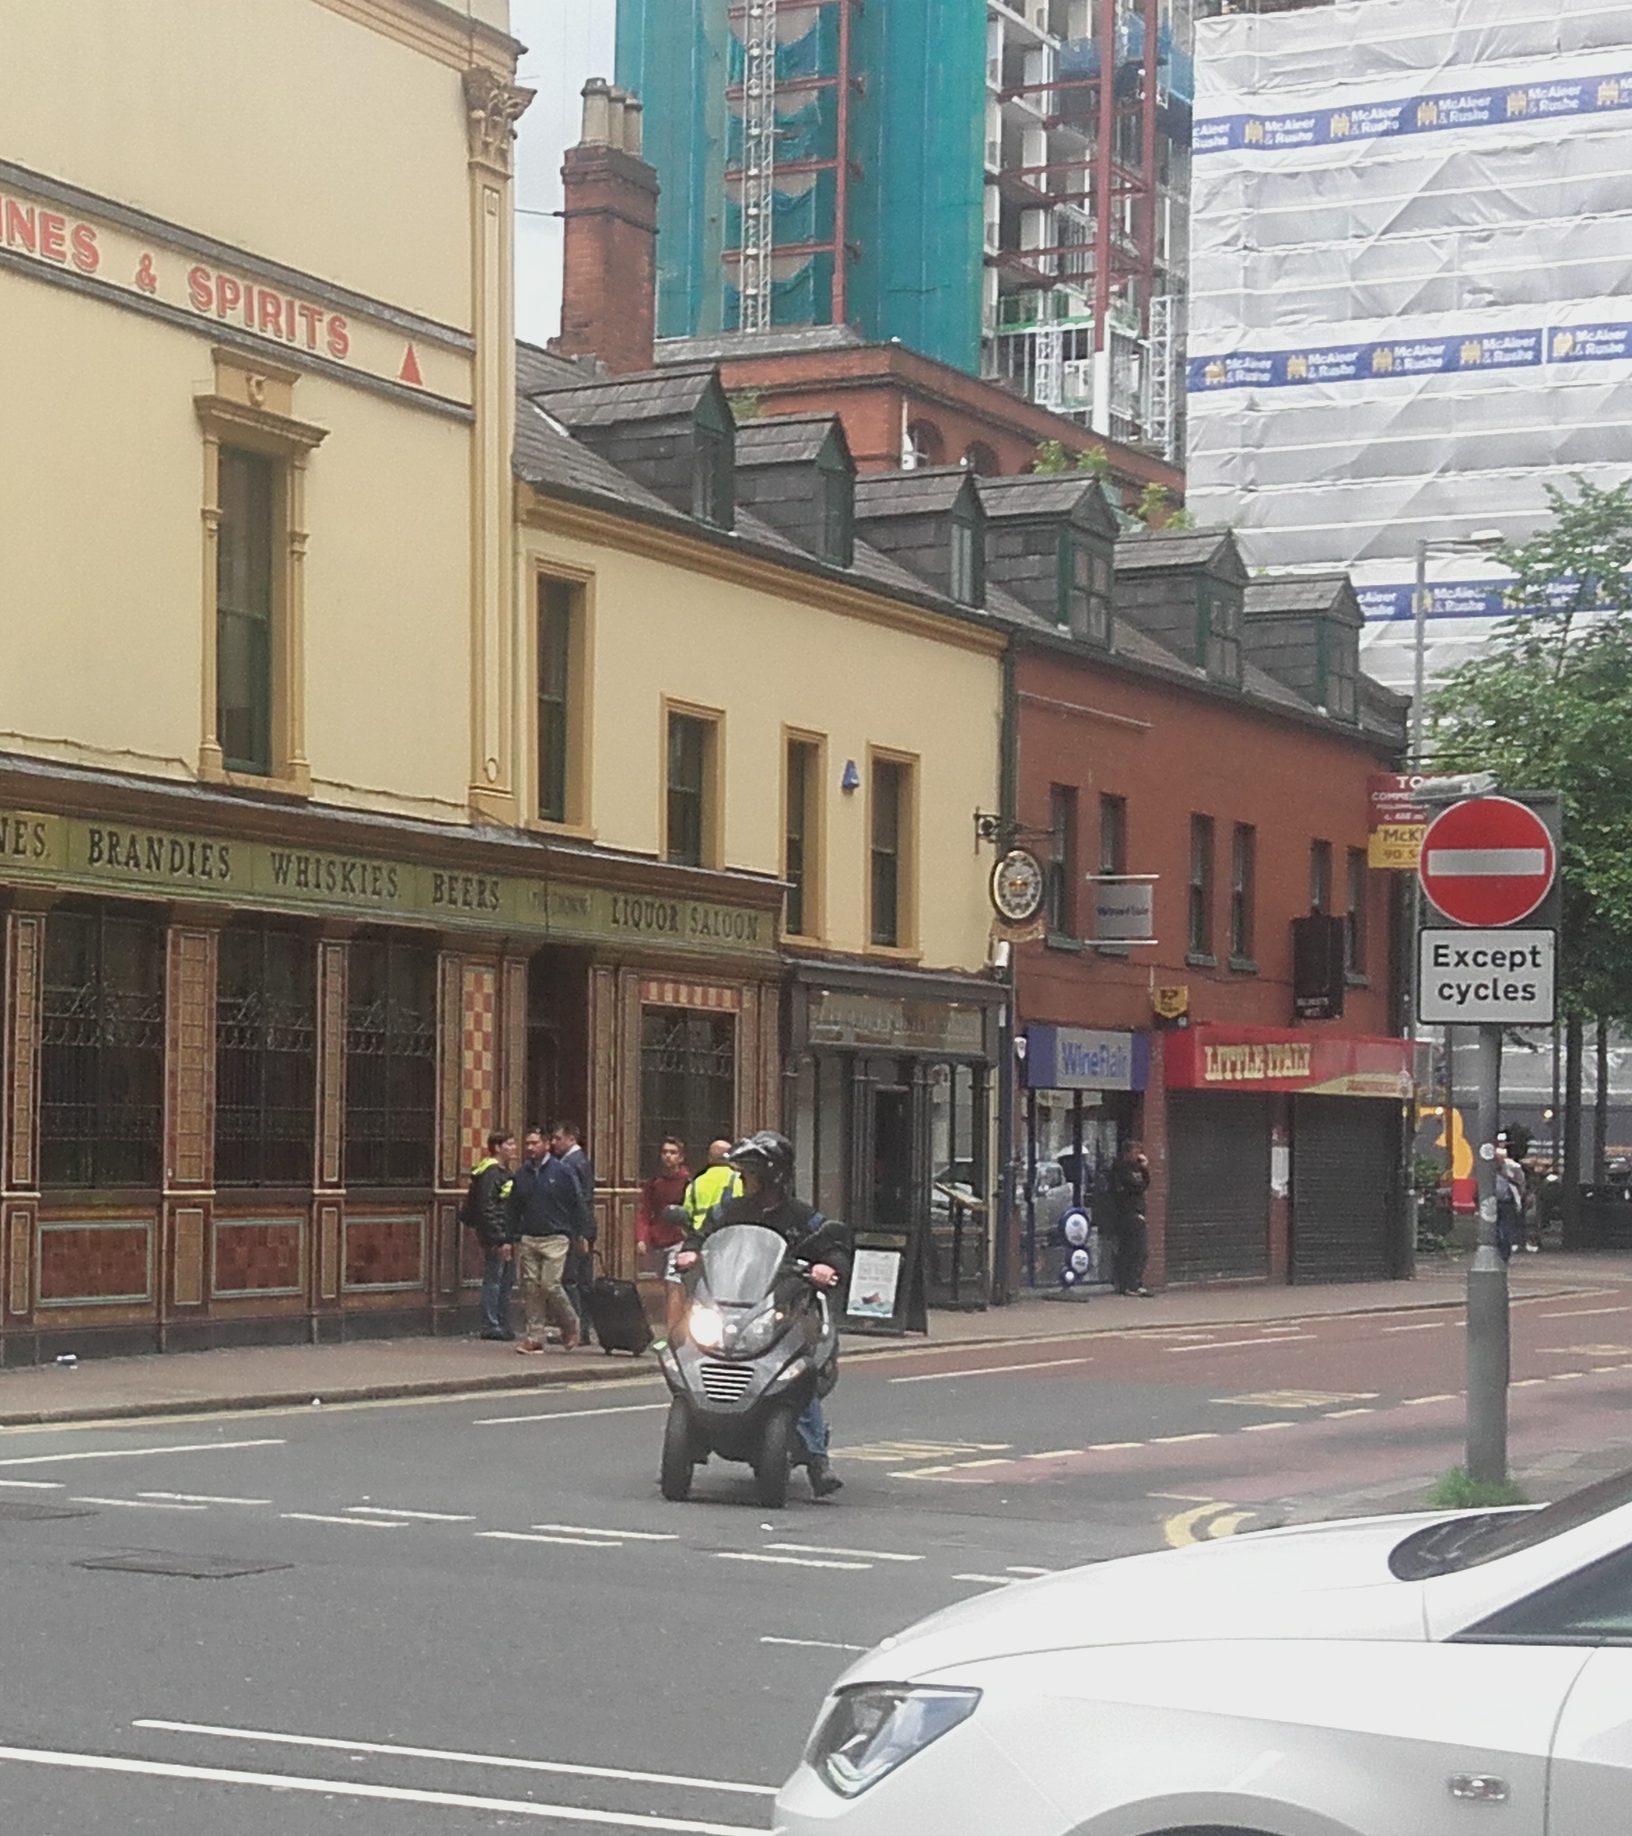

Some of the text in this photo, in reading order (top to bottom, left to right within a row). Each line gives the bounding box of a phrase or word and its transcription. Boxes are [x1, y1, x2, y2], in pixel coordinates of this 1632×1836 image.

[1193, 122, 1230, 137] cAleer
[135, 253, 156, 293] &
[187, 266, 350, 359] SPIRITS
[88, 828, 231, 880] BRANDIES
[432, 872, 500, 912] BEERS
[611, 894, 679, 933] LIQUOR
[690, 905, 759, 941] SALOON
[1433, 944, 1542, 972] Except
[1438, 978, 1536, 1005] cycles
[1204, 1043, 1310, 1080] LITTLE ITALY
